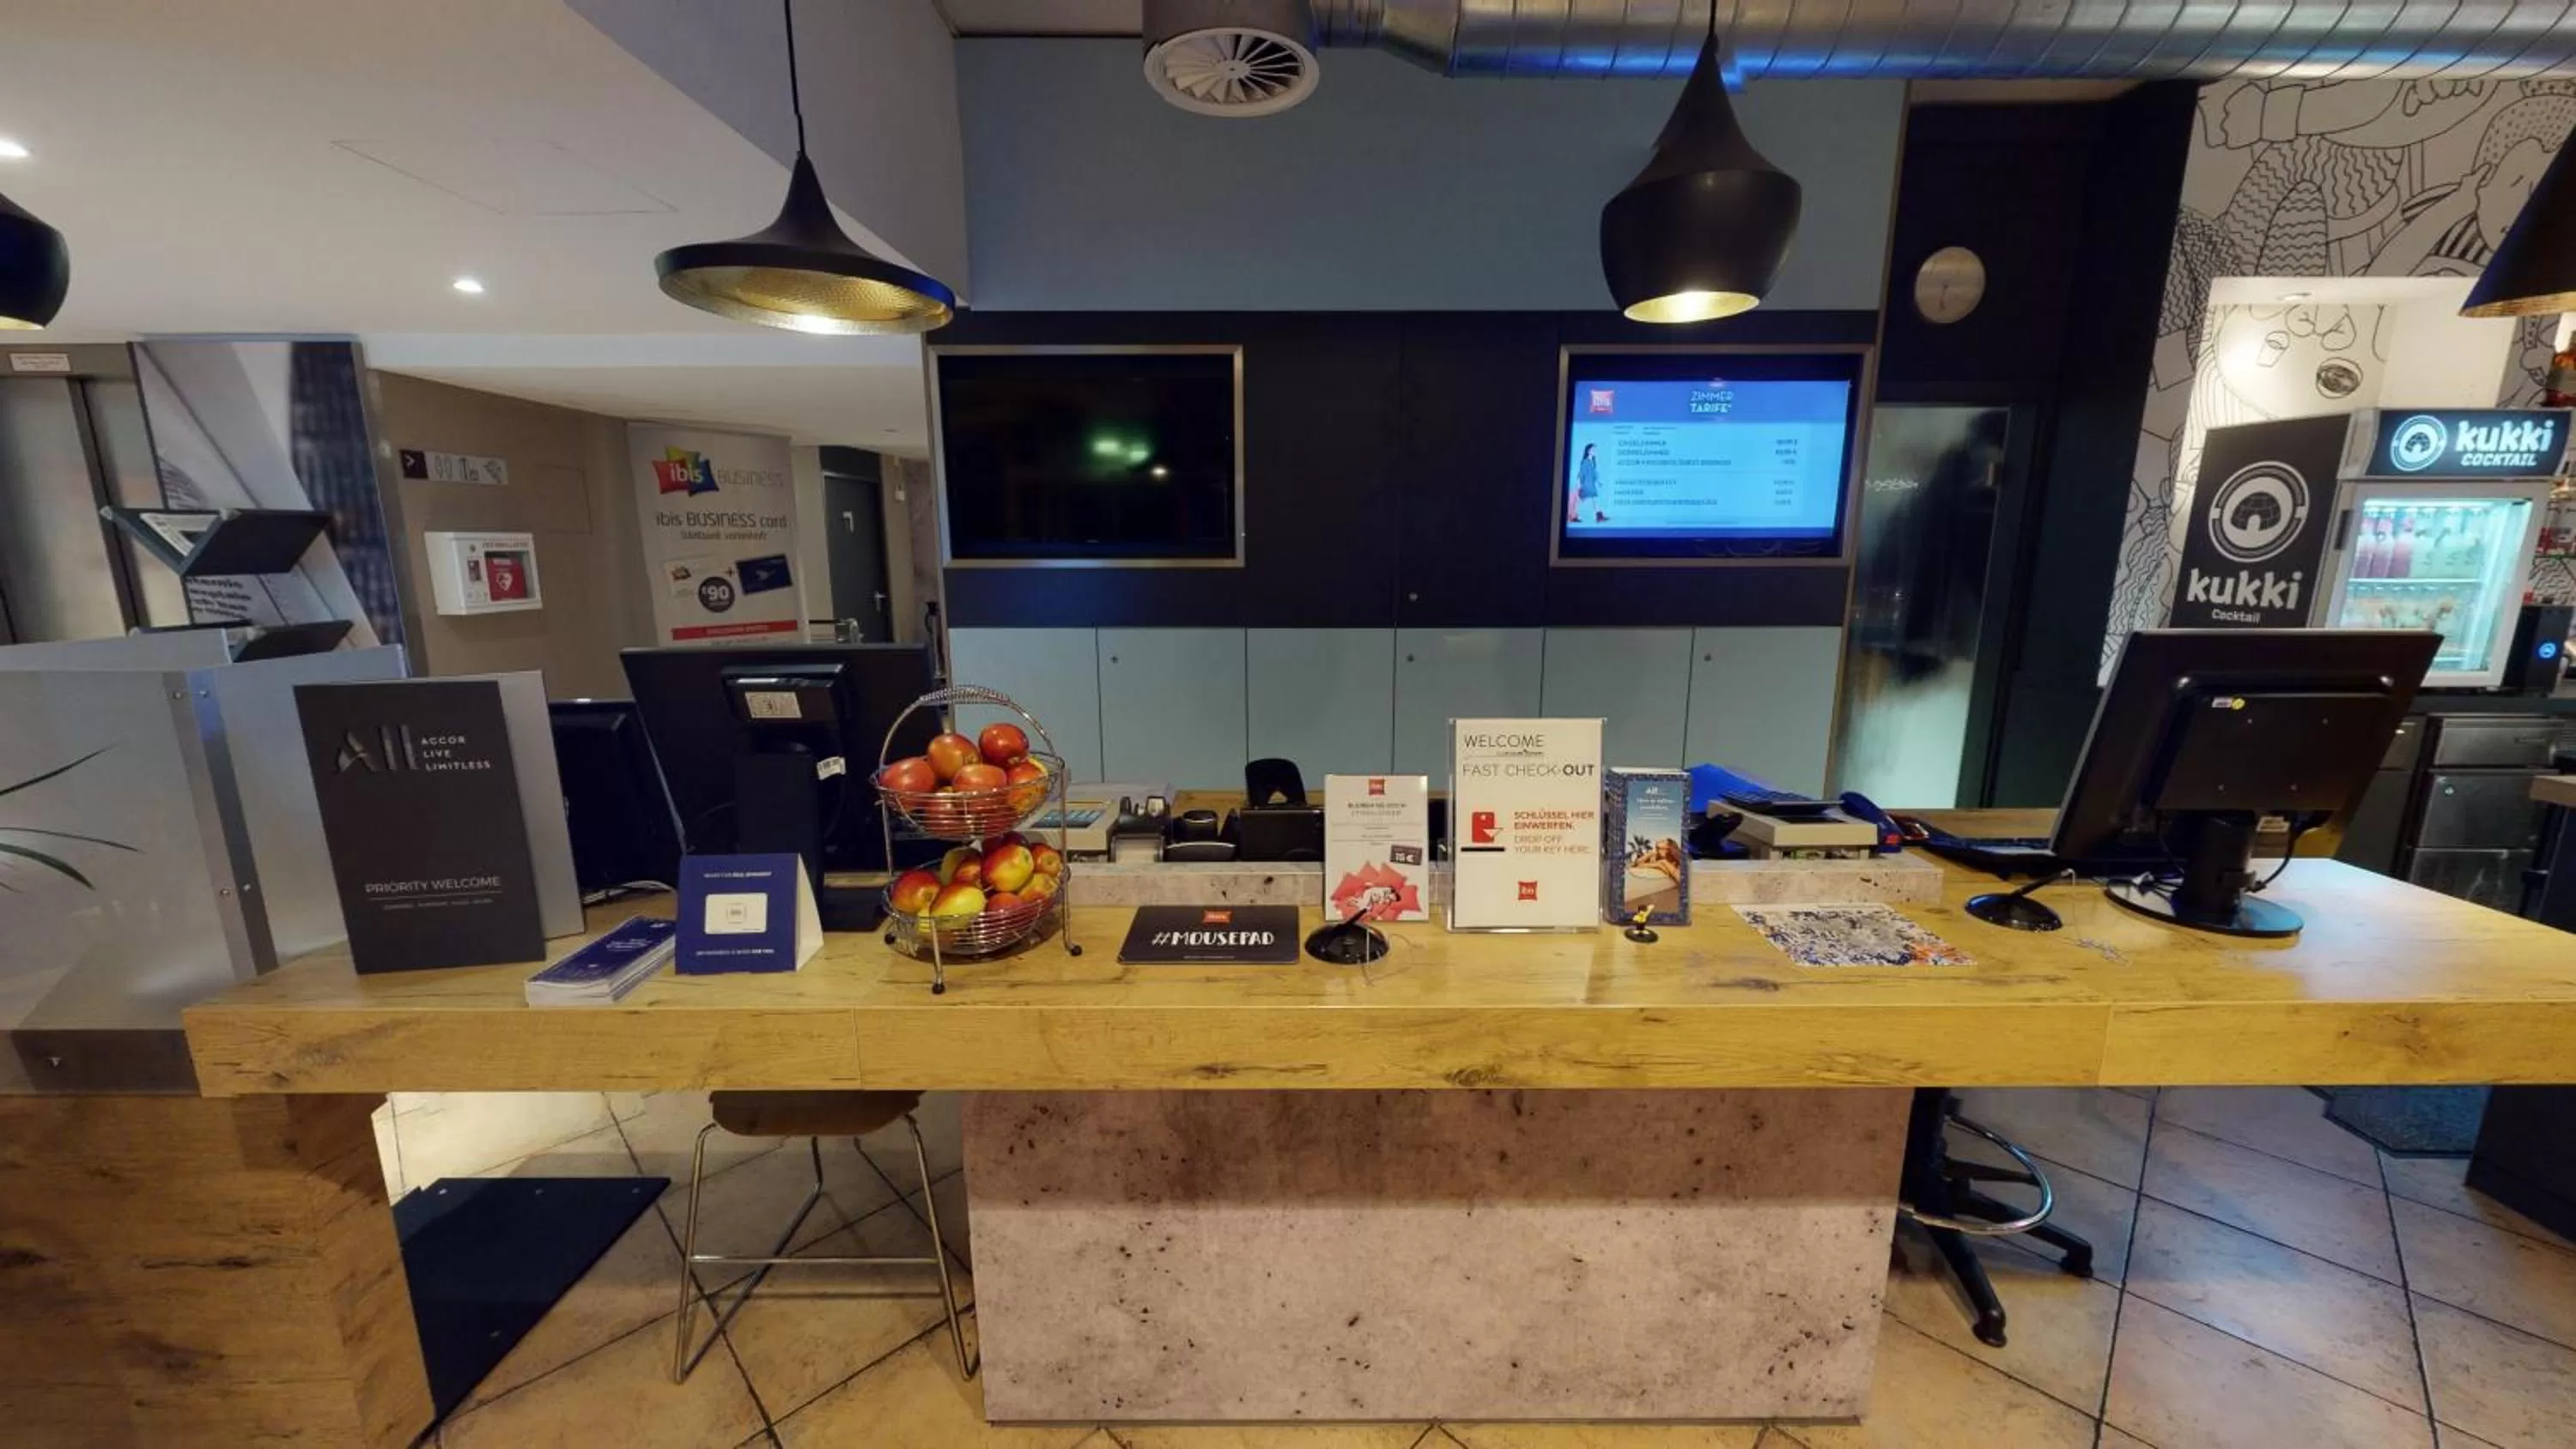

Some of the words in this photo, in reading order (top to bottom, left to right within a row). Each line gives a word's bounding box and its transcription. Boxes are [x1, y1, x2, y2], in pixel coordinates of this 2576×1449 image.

[1691, 391, 1733, 401] ZIMMER
[2456, 418, 2555, 452] kukki
[2460, 453, 2537, 467] COCKTAIL
[669, 463, 704, 483] ibis
[717, 470, 784, 488] BUSINESS
[656, 512, 682, 527] ibis
[686, 512, 756, 529] BUSINESS
[759, 515, 787, 529] card
[2187, 567, 2303, 609] kukki
[2211, 609, 2261, 623] Cocktail
[421, 735, 466, 746] ACCOR
[1464, 734, 1545, 748] WELCOME
[423, 749, 452, 758] LIVE
[426, 761, 491, 772] LIMITLESS
[1462, 763, 1500, 777] FAST
[1504, 763, 1595, 777] CHECK-OUT
[1514, 808, 1568, 820] SCHLÜSSEL
[1571, 810, 1595, 820] HIER
[365, 880, 428, 894] PRIORITY
[431, 876, 501, 890] WELCOME
[1151, 931, 1275, 946] #MOUSEPAD
